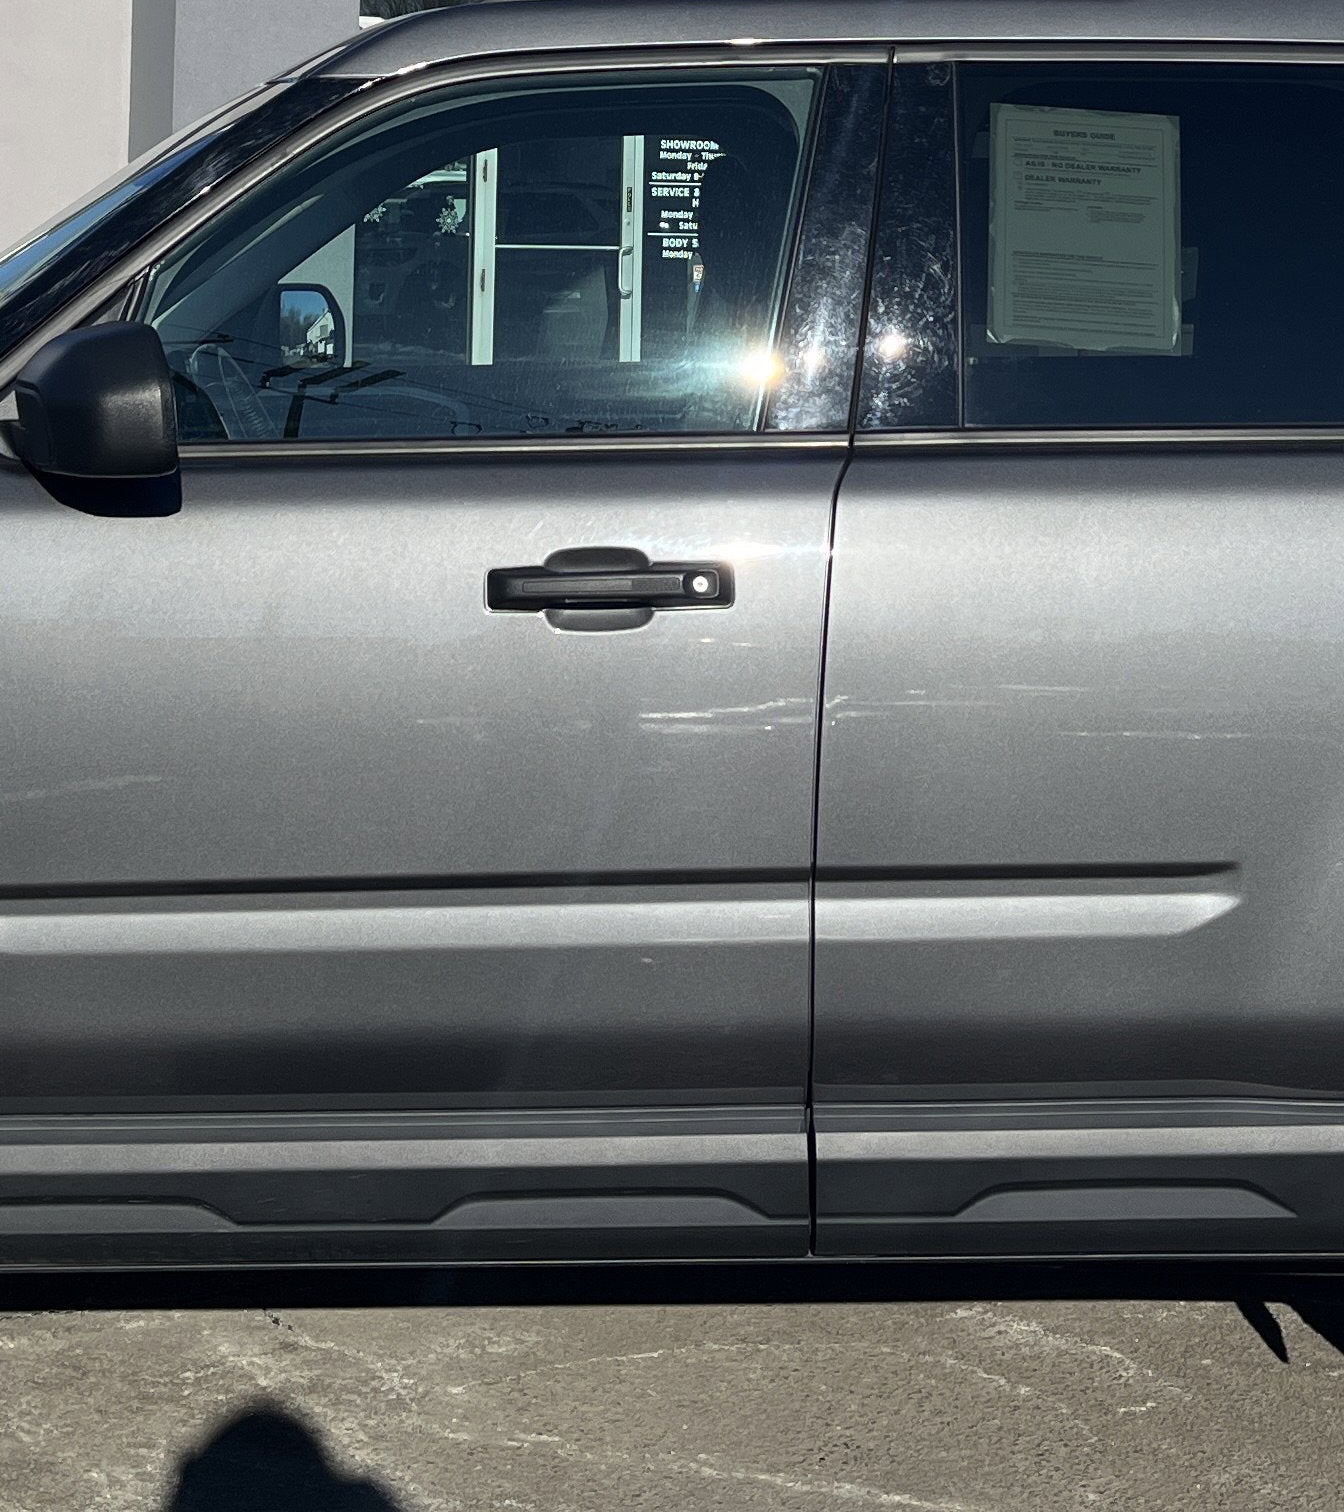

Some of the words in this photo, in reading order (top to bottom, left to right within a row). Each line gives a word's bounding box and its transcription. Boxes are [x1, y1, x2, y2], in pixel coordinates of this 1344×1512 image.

[659, 151, 693, 161] Monday
[1065, 163, 1096, 171] DEALER
[1098, 165, 1142, 174] WARRANTY
[651, 172, 692, 181] Saturday
[1024, 174, 1056, 183] DEALER
[1058, 176, 1102, 185] WARRANTY
[651, 187, 690, 197] SERVICE
[660, 210, 694, 220] Monday
[662, 238, 689, 248] BODY
[662, 250, 694, 260] Monday
